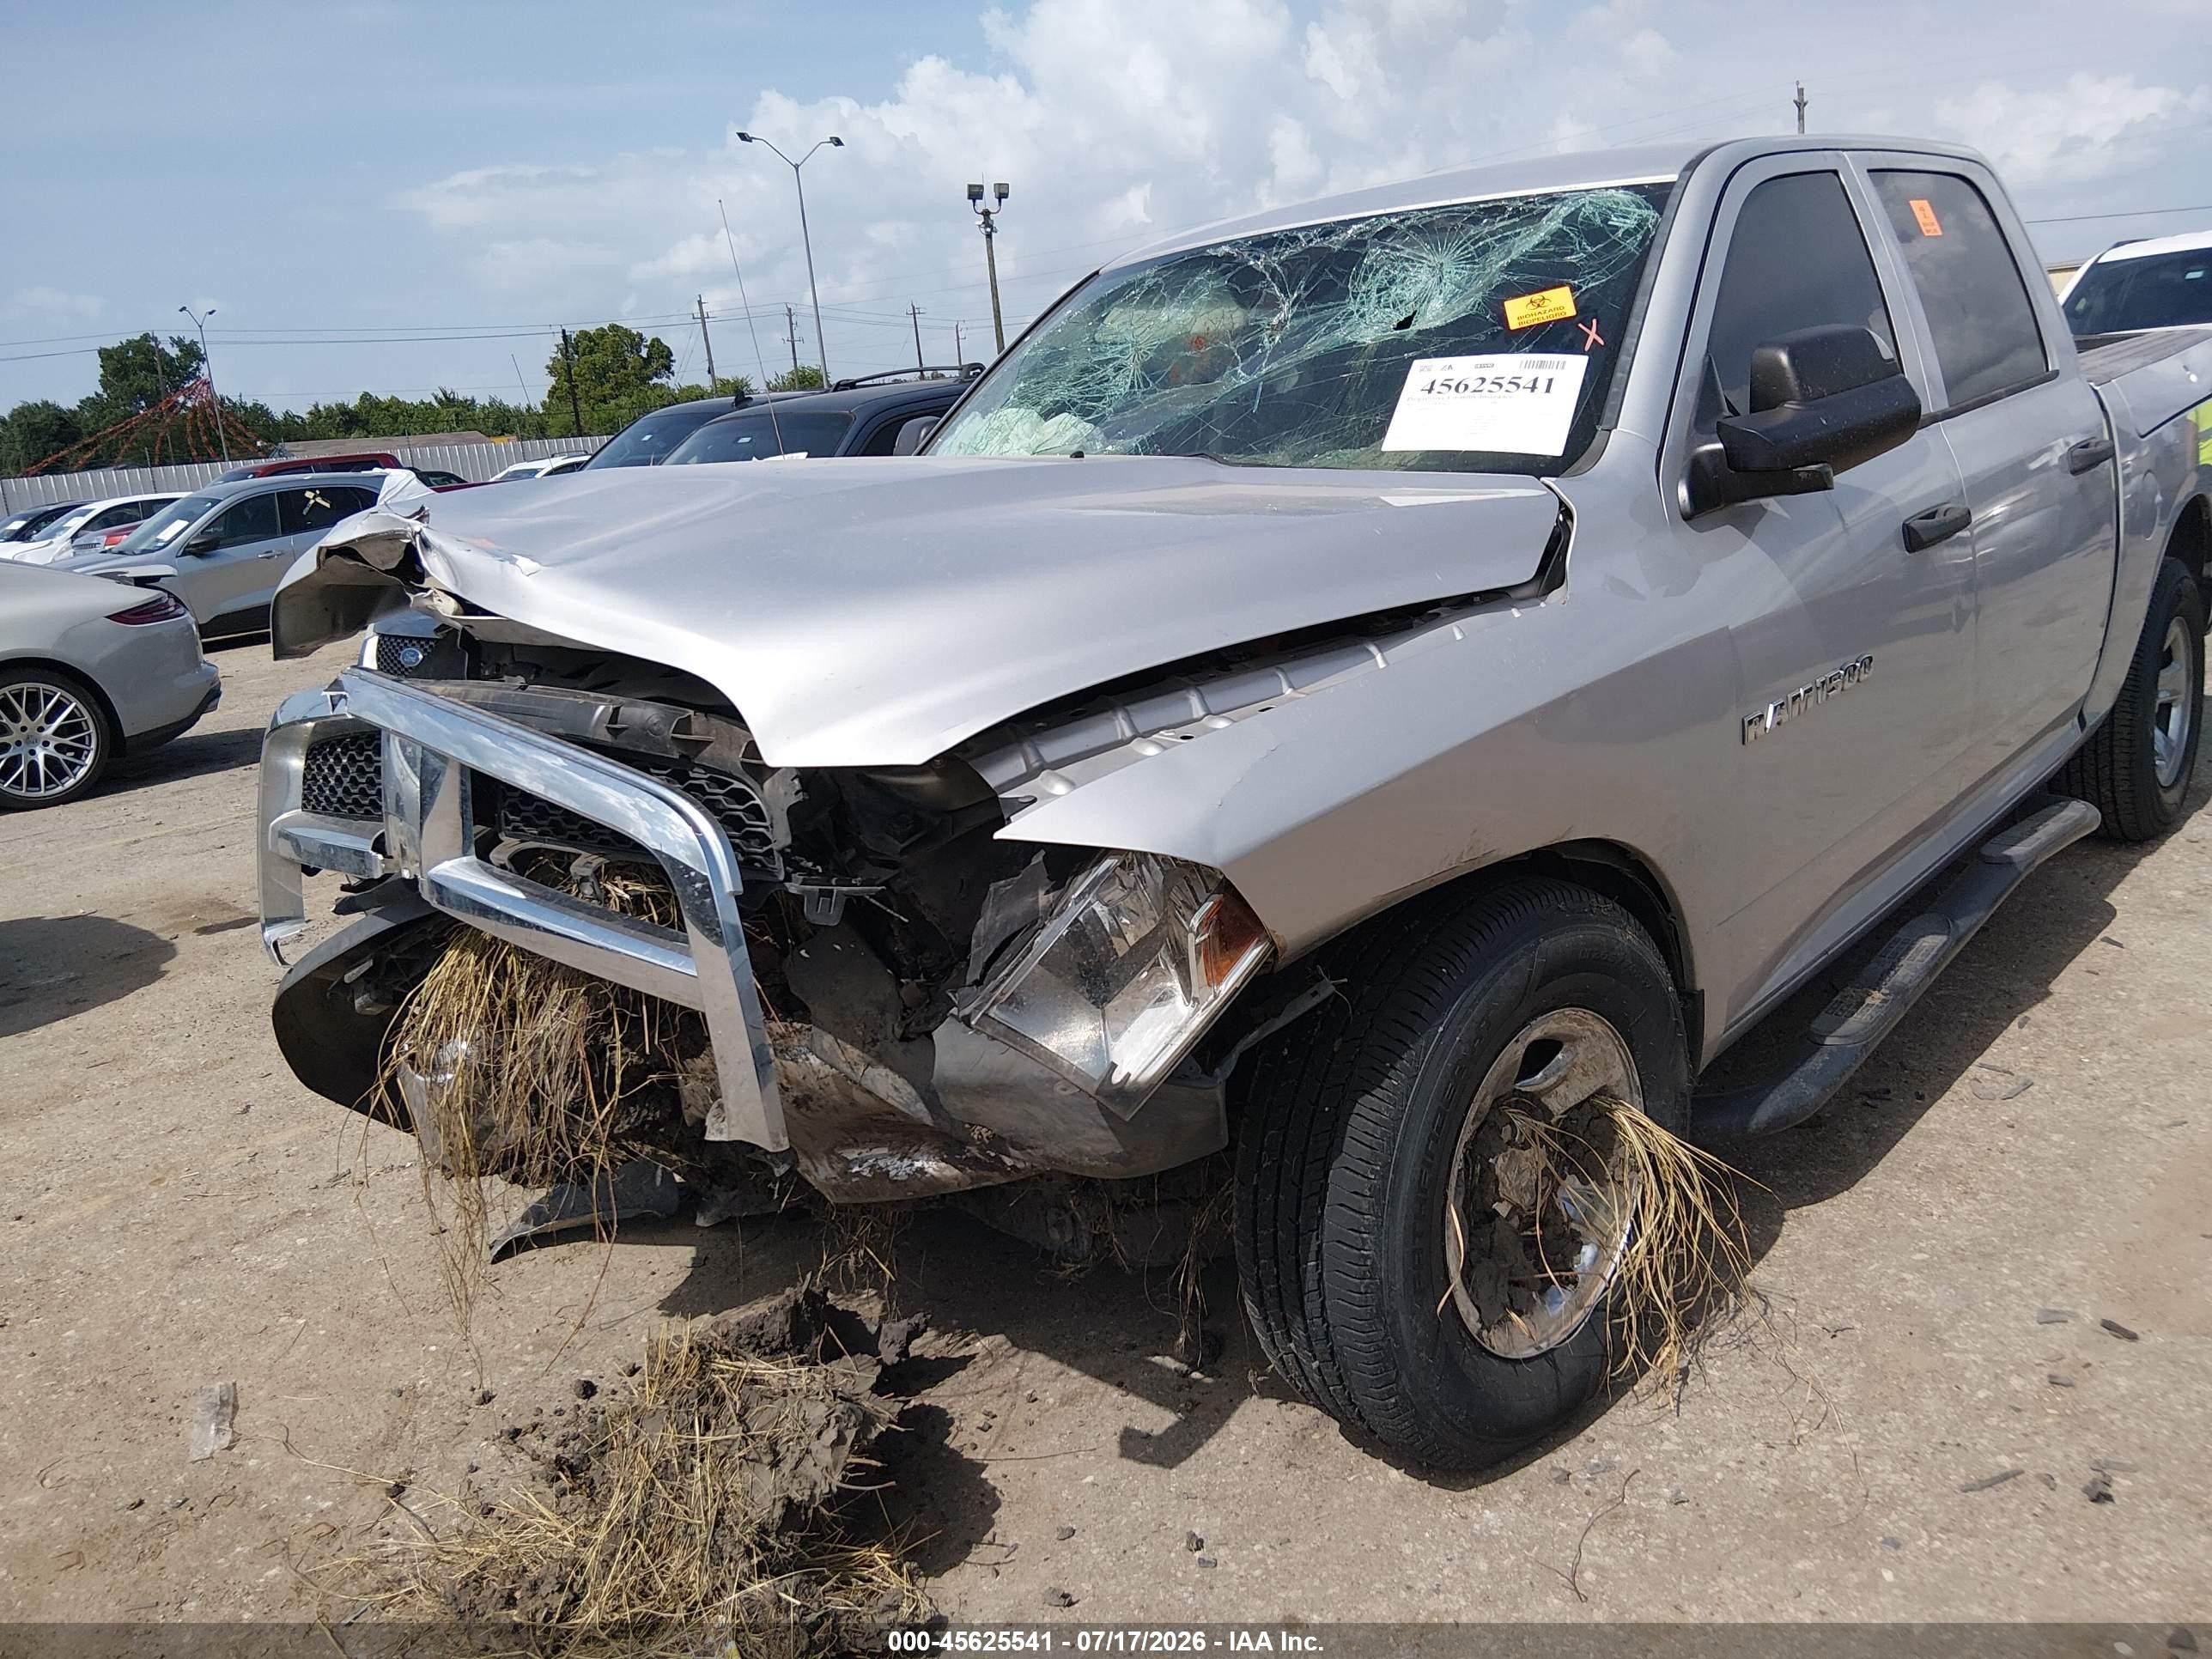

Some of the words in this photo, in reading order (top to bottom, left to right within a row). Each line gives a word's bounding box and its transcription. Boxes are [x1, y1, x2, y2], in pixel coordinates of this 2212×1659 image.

[1516, 306, 1565, 321] BIOHAZARD
[1518, 312, 1567, 326] BIOPELIGRO
[1420, 376, 1554, 394] 45625541
